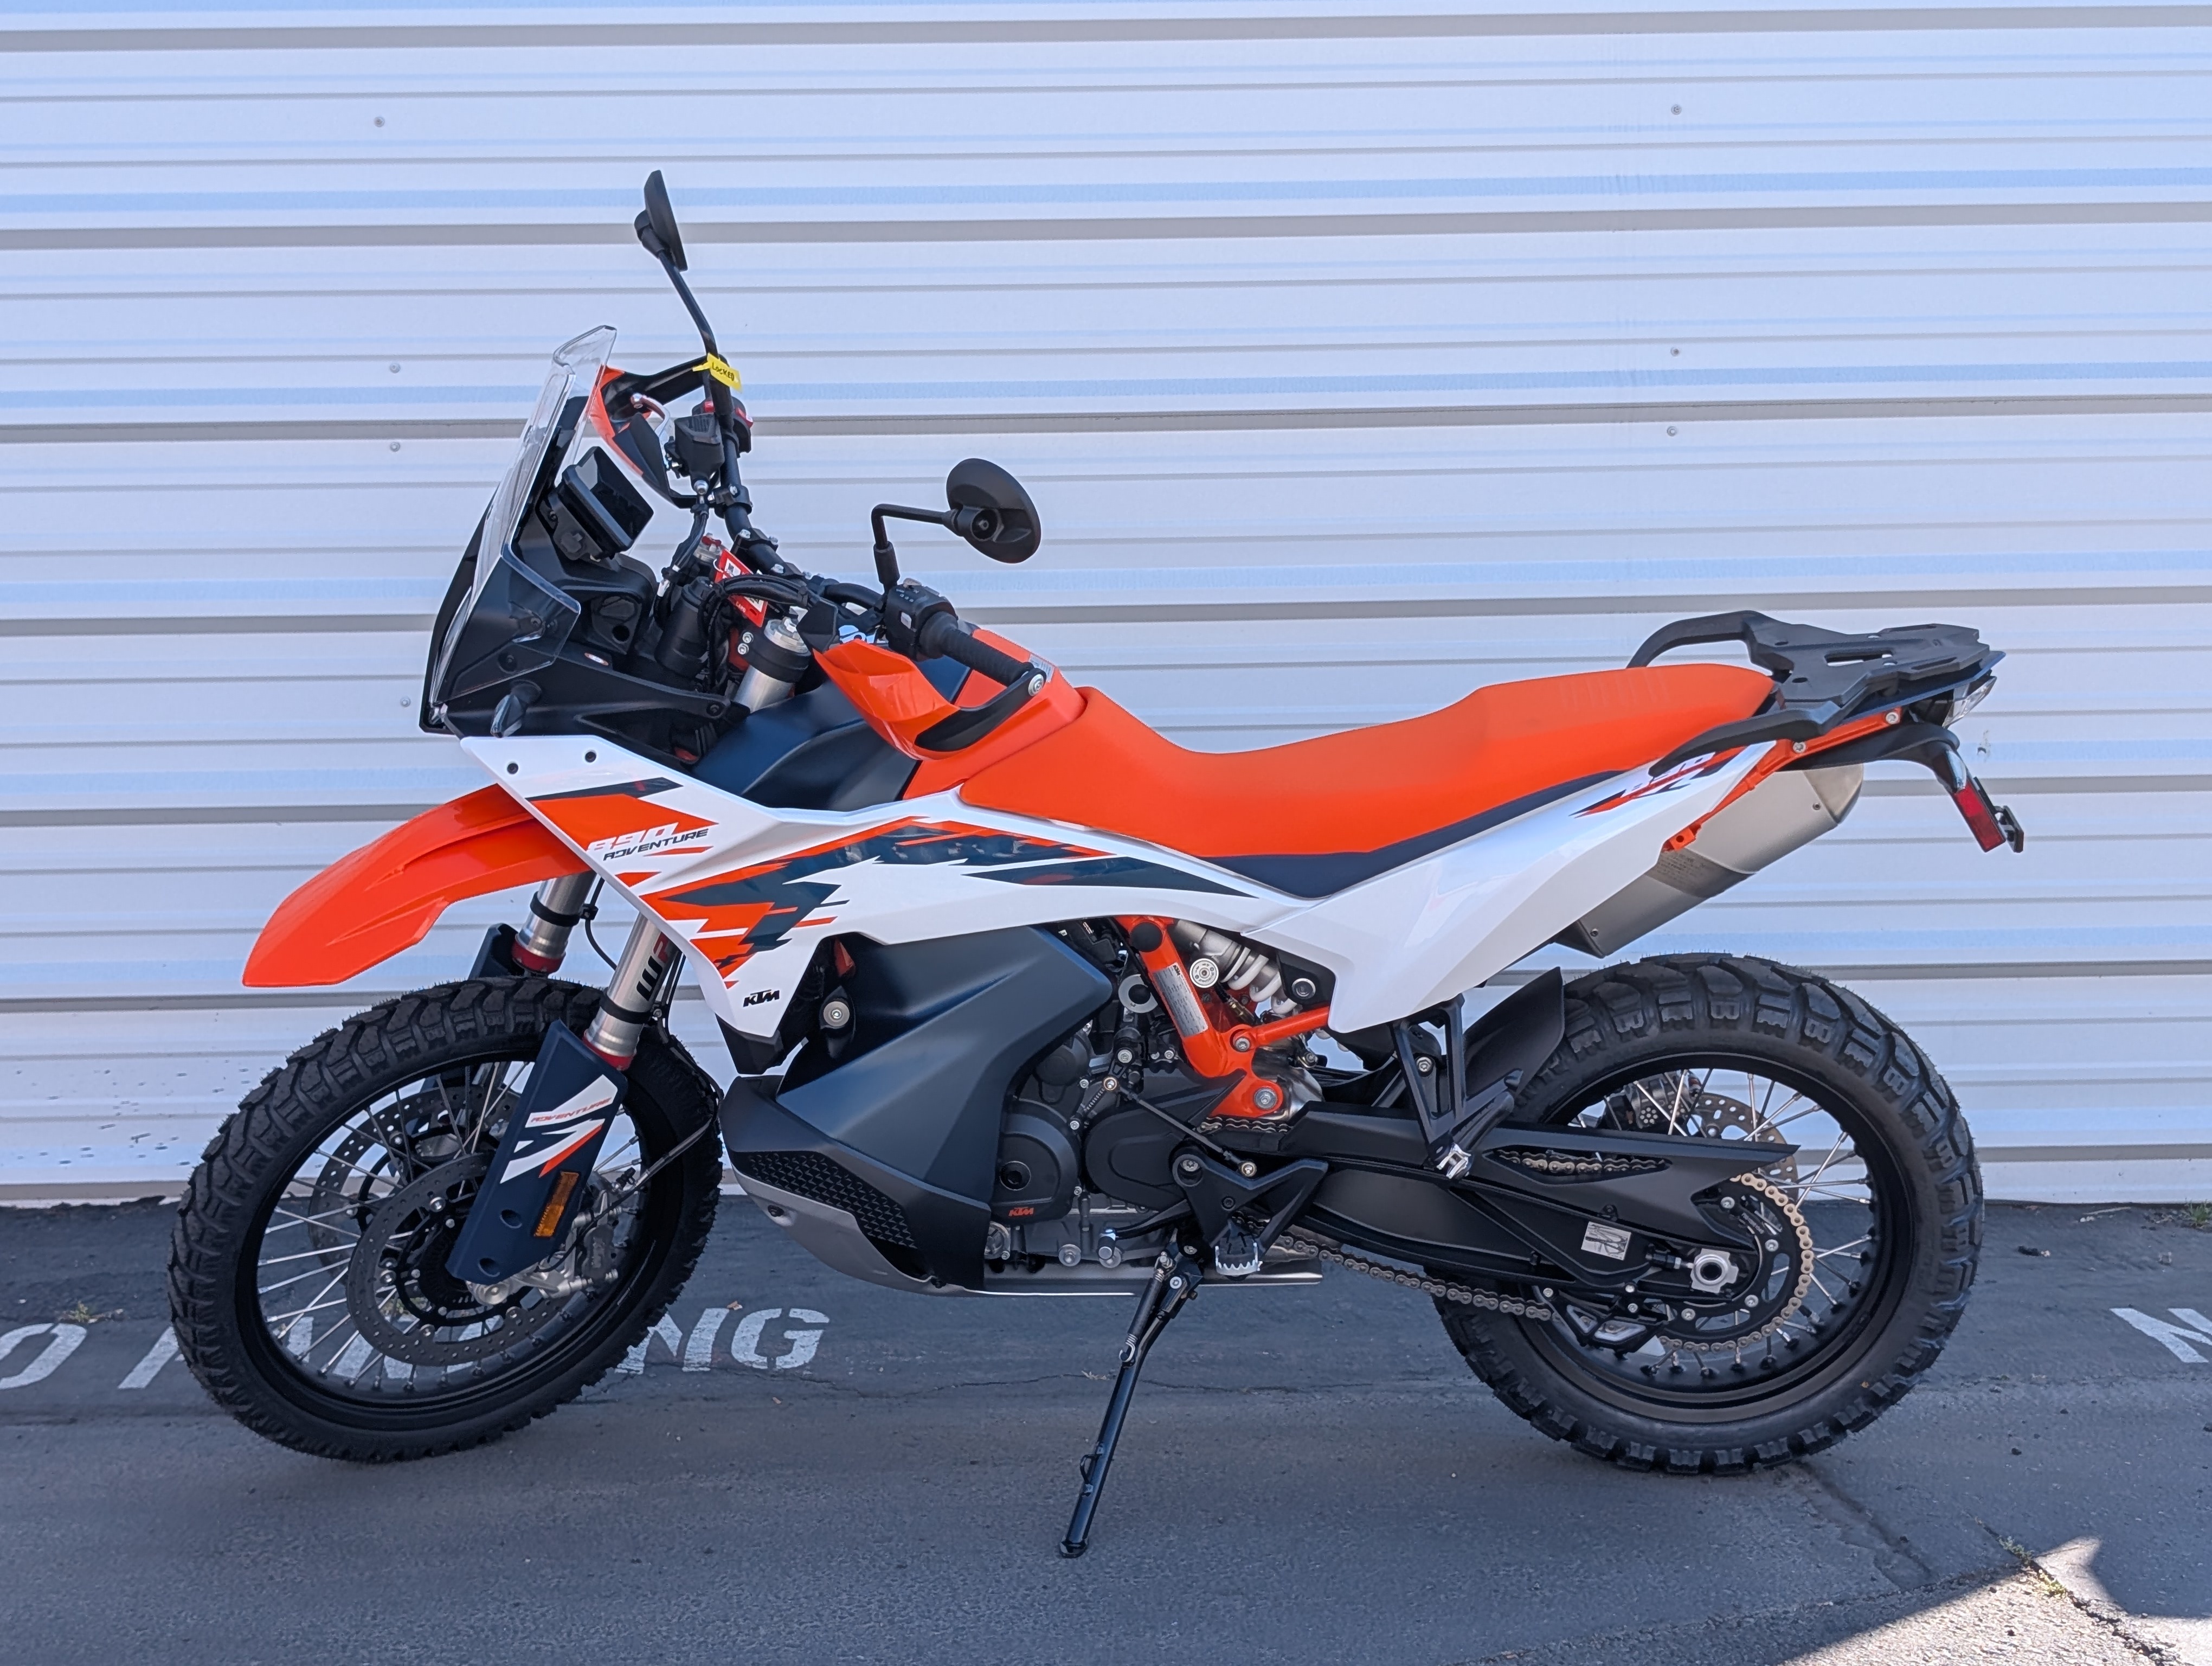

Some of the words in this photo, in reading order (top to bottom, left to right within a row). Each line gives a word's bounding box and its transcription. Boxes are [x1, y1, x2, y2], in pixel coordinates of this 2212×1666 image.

[587, 822, 679, 851] 890
[603, 828, 709, 861] ADVENTURE
[743, 989, 780, 1007] KTM
[531, 1097, 612, 1123] ADVENTURE
[1008, 1207, 1034, 1216] KTM
